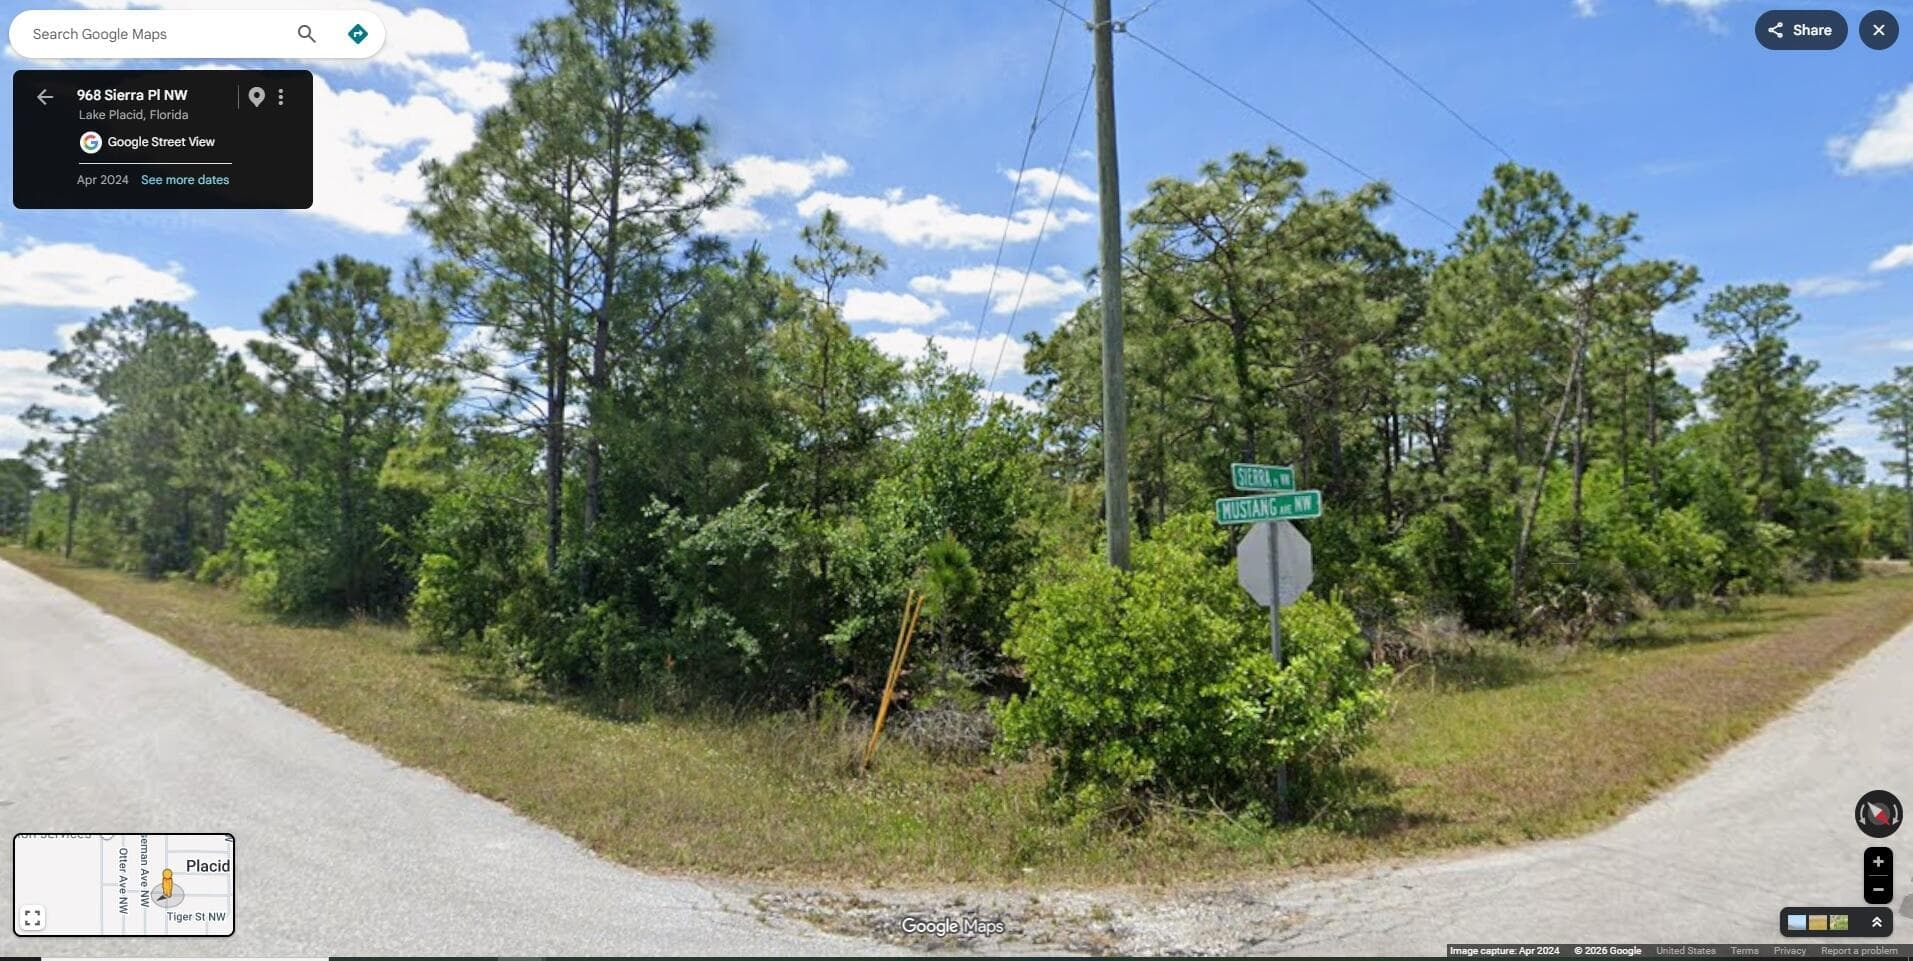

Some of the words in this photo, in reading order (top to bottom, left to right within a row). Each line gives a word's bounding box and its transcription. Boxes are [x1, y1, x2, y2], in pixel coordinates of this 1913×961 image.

[1237, 467, 1272, 488] SIERRA
[1222, 498, 1278, 520] MUSTANG
[1280, 504, 1292, 514] AVE
[1294, 495, 1312, 512] NW
